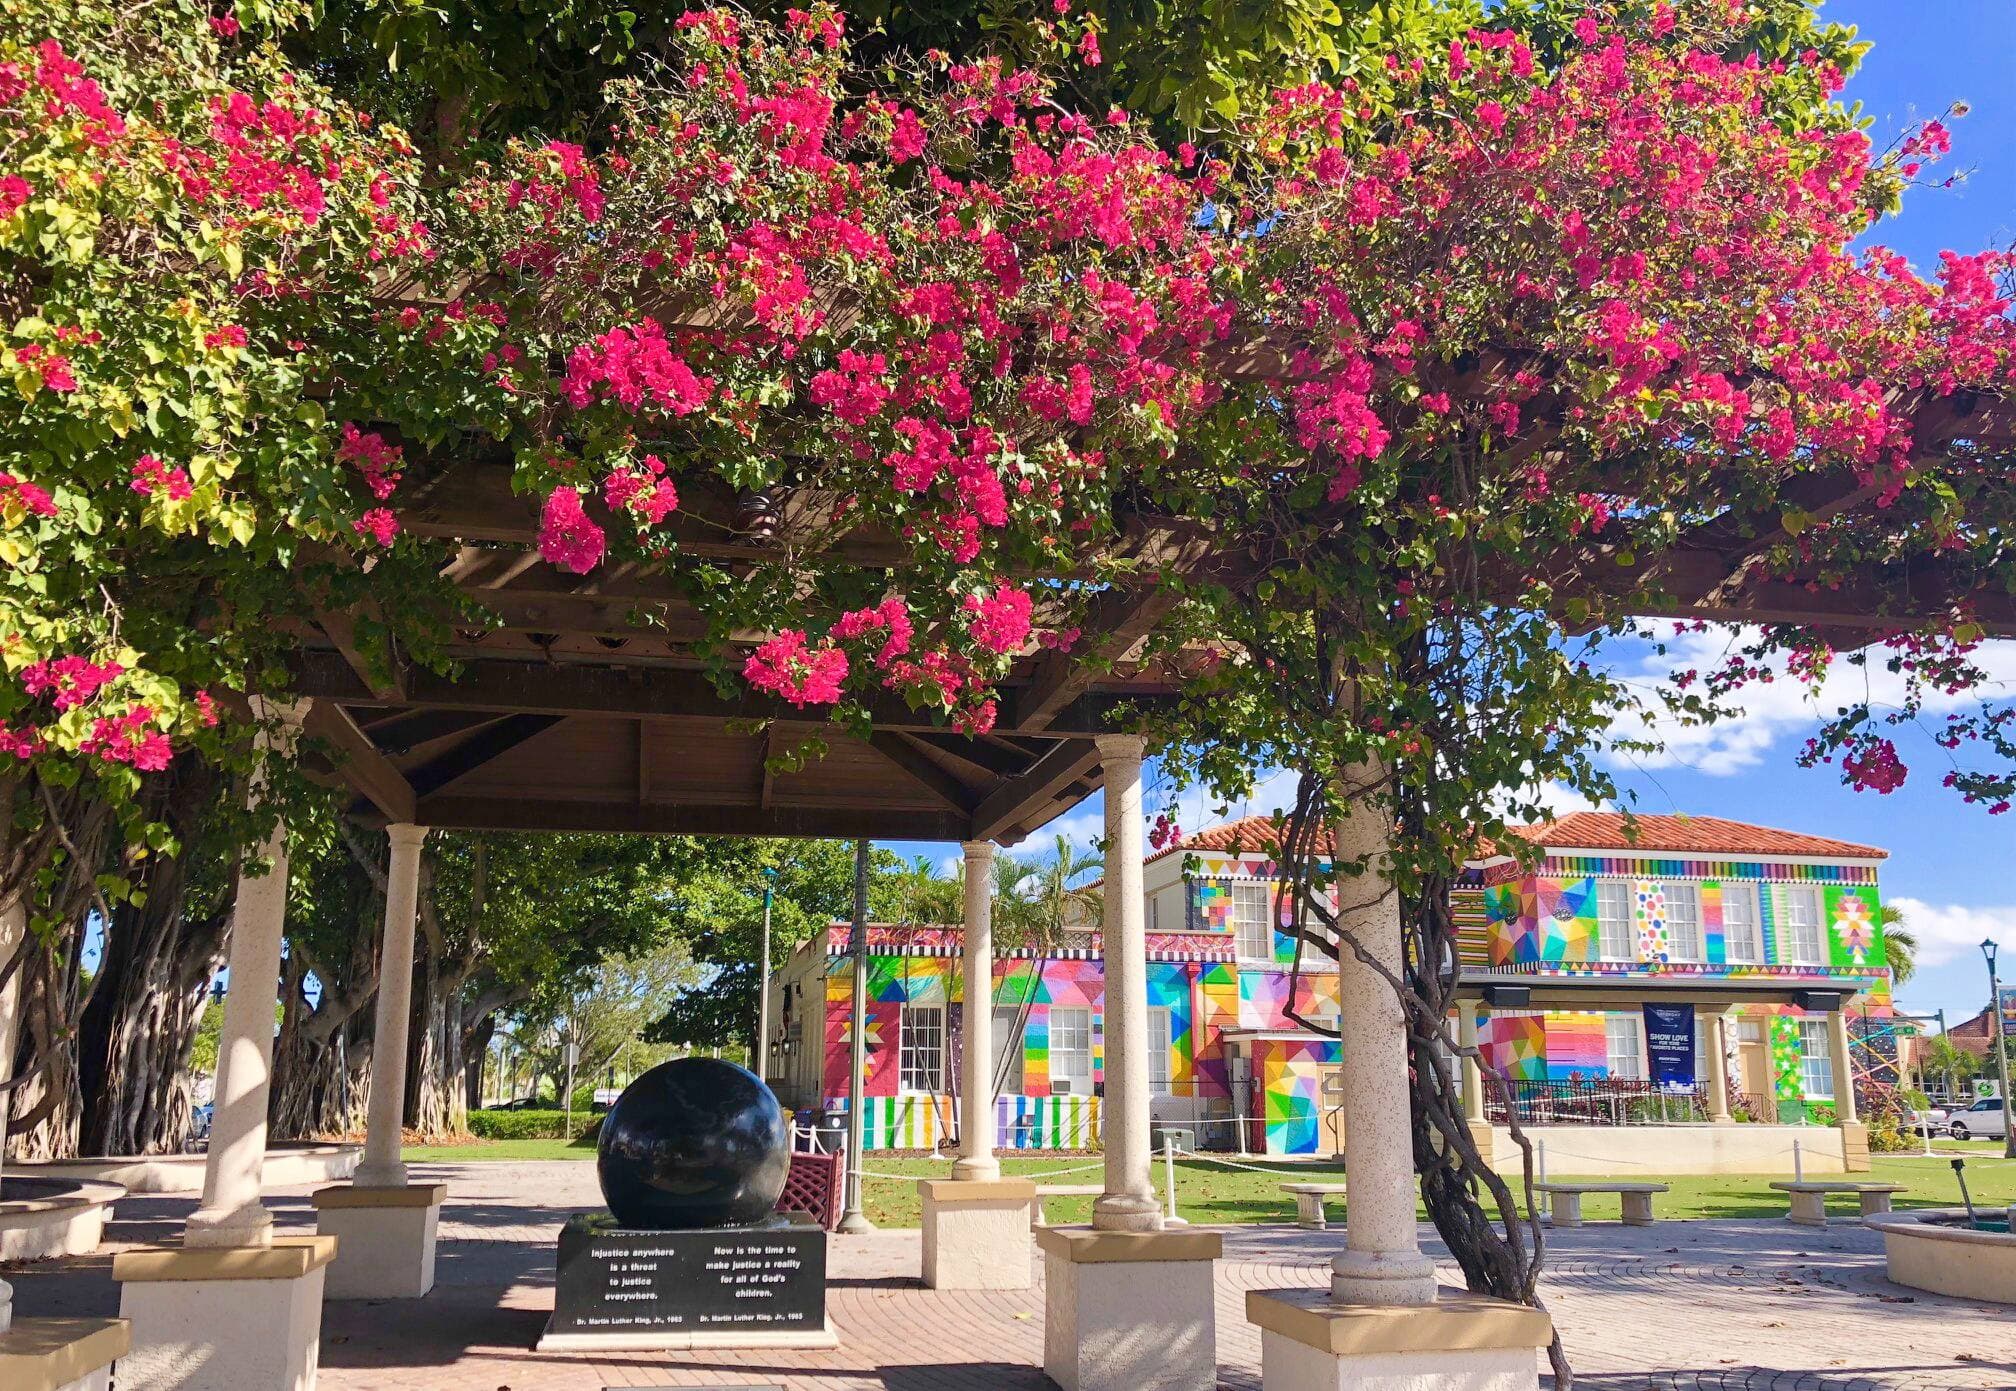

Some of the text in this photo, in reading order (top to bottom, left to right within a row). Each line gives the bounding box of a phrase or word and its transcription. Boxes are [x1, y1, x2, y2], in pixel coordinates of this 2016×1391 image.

[591, 1248, 675, 1259] Injustice anywhere
[714, 1246, 797, 1255] Now is the time to
[609, 1262, 618, 1271] is
[630, 1262, 657, 1271] threat
[705, 1260, 801, 1271] make justice a reality
[609, 1277, 652, 1287] to justice
[720, 1274, 786, 1284] for all of God's
[604, 1292, 658, 1301] everywhere.
[735, 1290, 773, 1298] children.
[588, 1317, 610, 1325] Martin
[611, 1317, 633, 1325] Luther
[634, 1316, 652, 1324] King,
[699, 1315, 710, 1323] Dr.
[712, 1314, 732, 1322] Martin
[734, 1314, 755, 1322] Luther
[756, 1314, 773, 1322] King,
